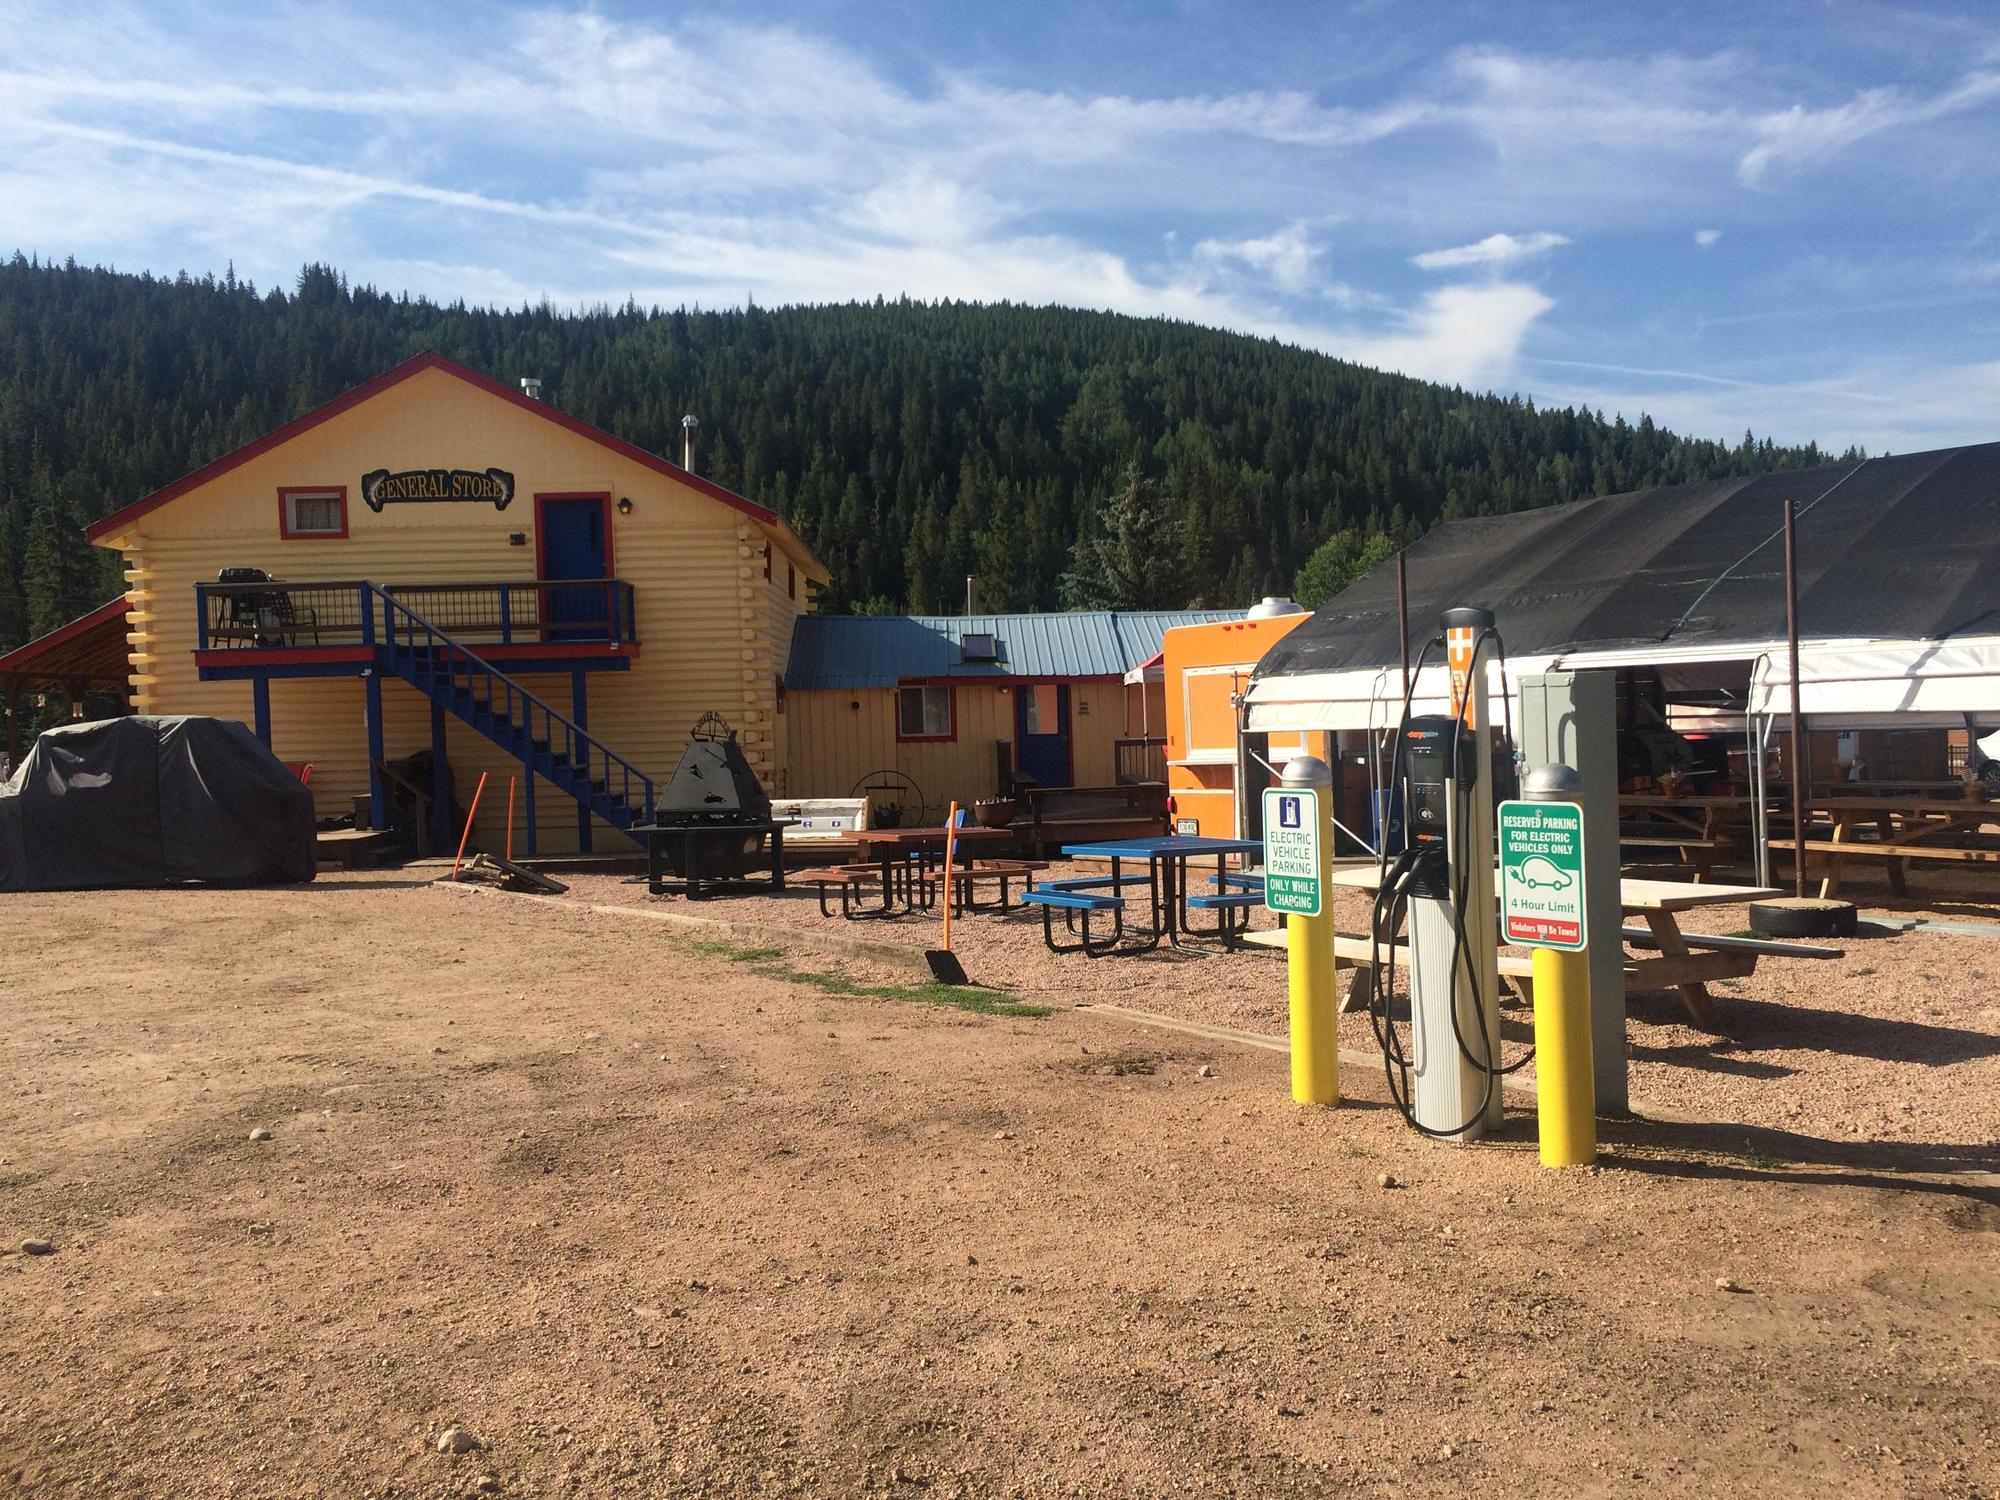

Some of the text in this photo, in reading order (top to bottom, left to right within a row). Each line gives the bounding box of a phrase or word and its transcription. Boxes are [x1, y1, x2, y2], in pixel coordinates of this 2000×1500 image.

[375, 473, 503, 499] GENERAL STORE
[1503, 815, 1578, 830] RESERVED PARKING
[1270, 831, 1312, 845] ELECTRIC
[1511, 830, 1571, 843] FOR ELECTRIC
[1273, 846, 1310, 860] VEHICLE
[1508, 842, 1574, 855] VEHICLES ONLY
[1272, 860, 1312, 875] PARKING
[1270, 878, 1315, 894] ONLY WHILE
[1274, 893, 1312, 909] CHARGING
[1511, 899, 1575, 913] 4 Hour Limit
[1510, 921, 1536, 933] Violators
[1548, 925, 1557, 935] Be
[1557, 925, 1577, 937] Towed
